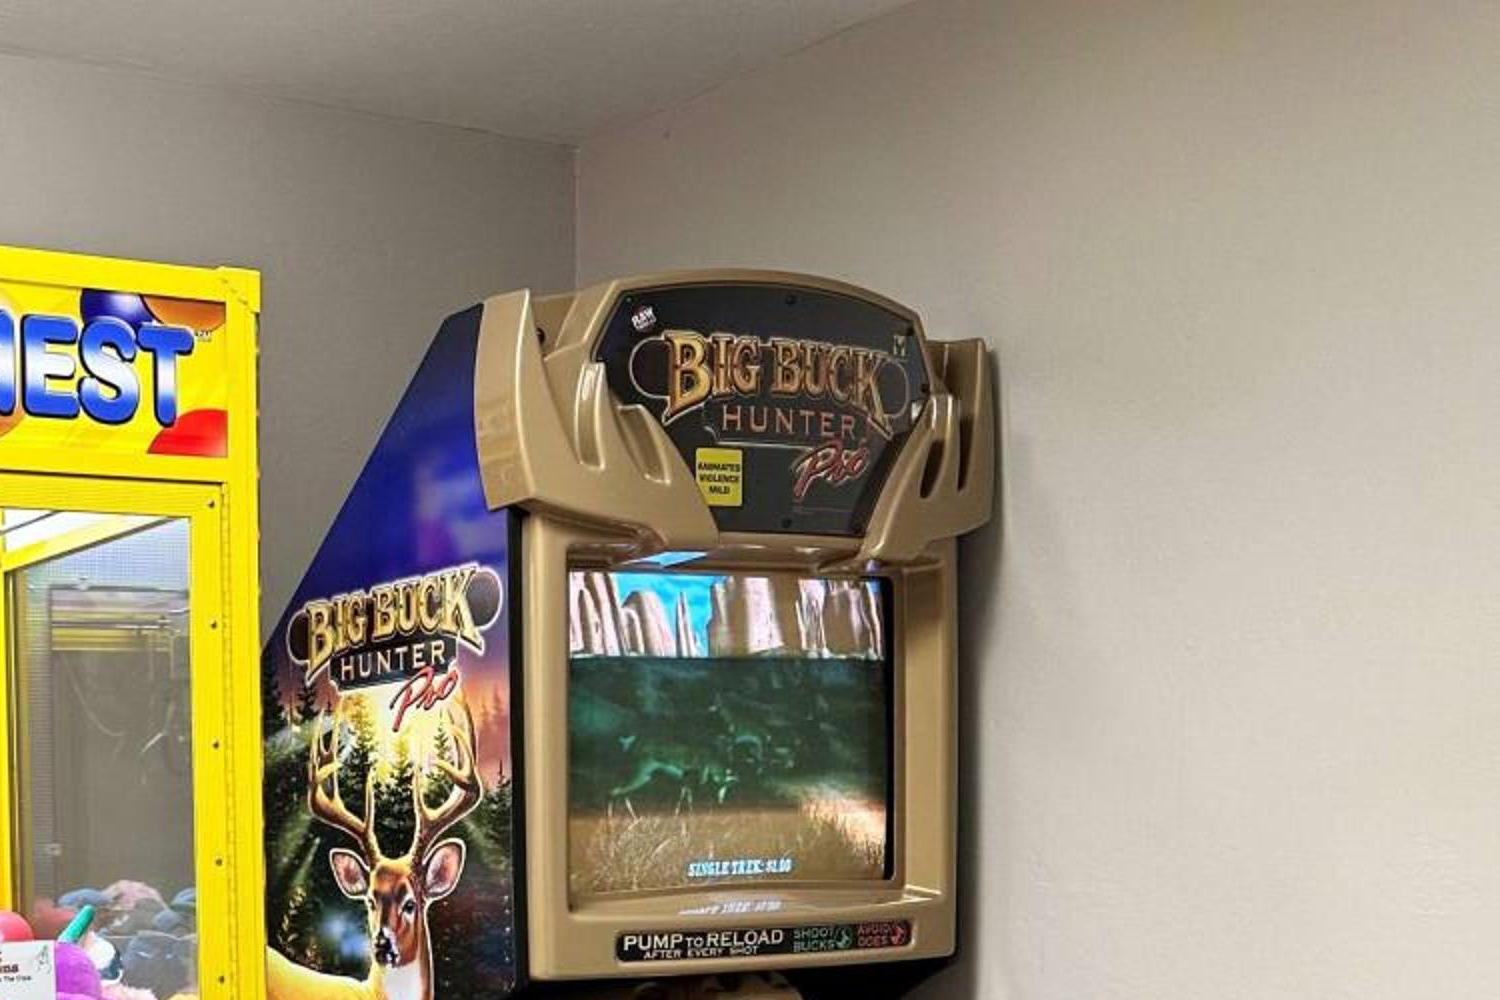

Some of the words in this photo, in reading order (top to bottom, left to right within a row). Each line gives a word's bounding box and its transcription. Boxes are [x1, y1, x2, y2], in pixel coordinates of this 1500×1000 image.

[661, 329, 762, 426] BIG
[769, 336, 894, 440] BUCK
[721, 404, 856, 439] HUNTER
[699, 474, 740, 484] VIOLENCE
[306, 592, 367, 685] BIG
[372, 565, 484, 652] BUCK
[340, 639, 446, 681] HUNTER
[623, 932, 684, 951] PUMP
[706, 929, 784, 948] RELOAD
[793, 927, 834, 939] SHOOT
[643, 951, 682, 960] AFTER
[687, 948, 725, 958] EVERY
[730, 946, 759, 956] SHOT
[793, 939, 836, 953] BUCKS
